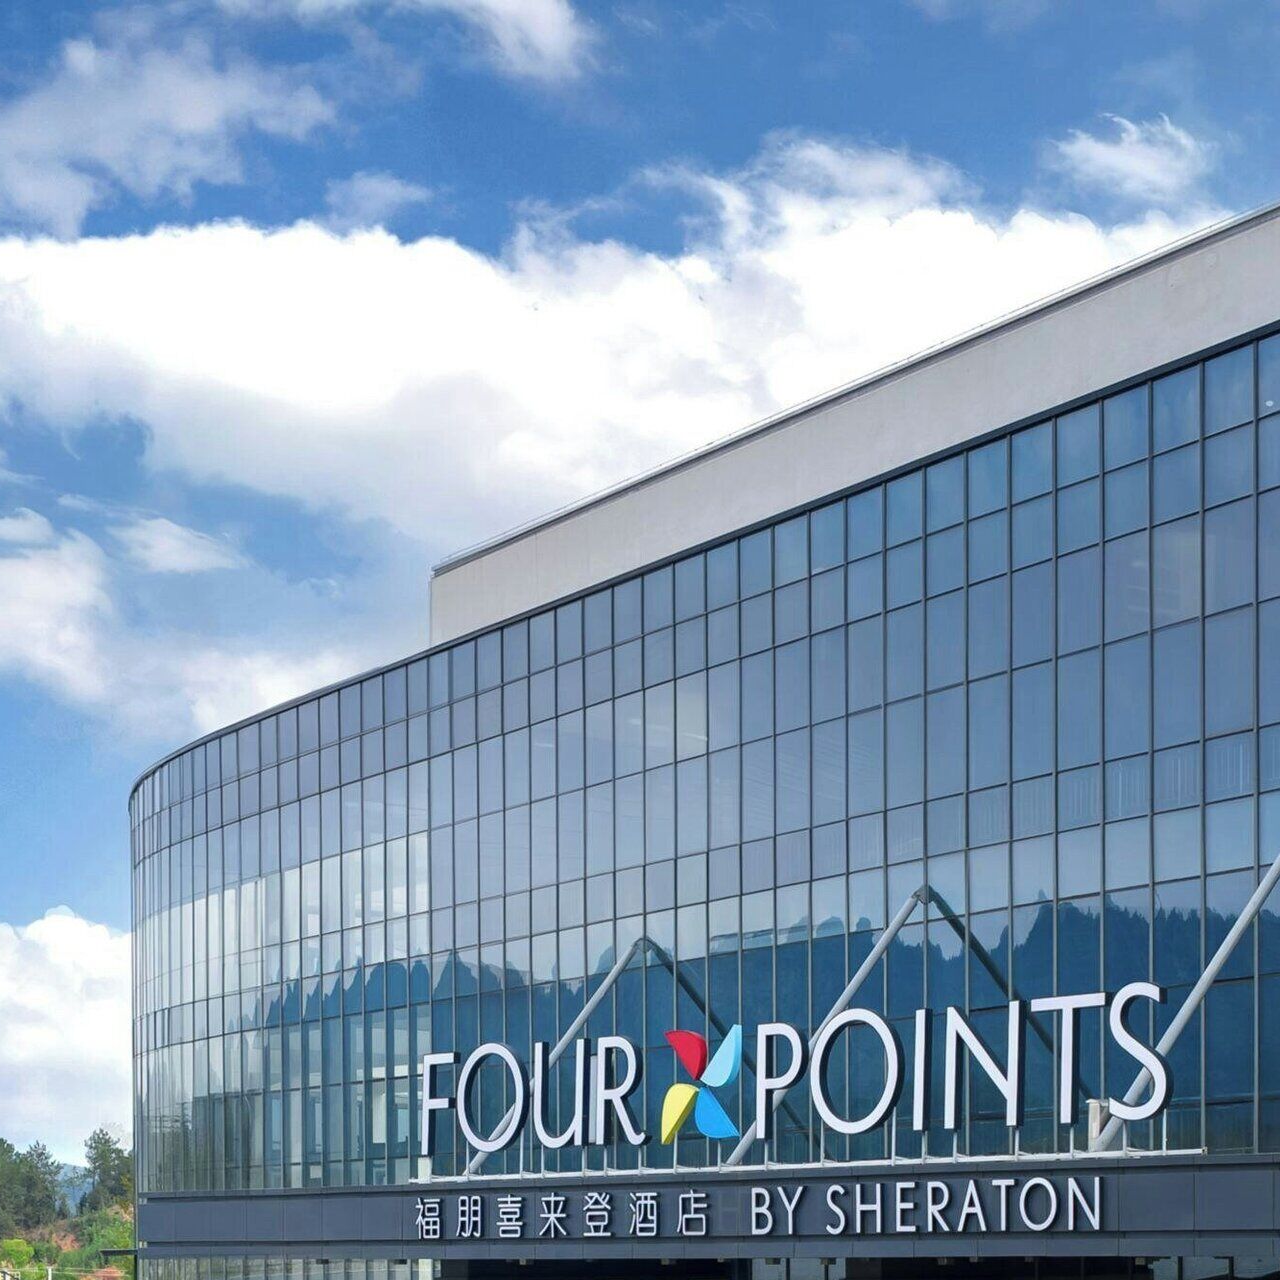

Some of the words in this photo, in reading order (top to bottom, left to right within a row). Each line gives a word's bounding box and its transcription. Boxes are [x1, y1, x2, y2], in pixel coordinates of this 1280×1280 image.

[421, 1035, 651, 1157] FOUR
[756, 980, 1172, 1140] POINTS
[415, 1190, 708, 1239] 福朋喜来登酒店
[751, 1185, 805, 1236] BY
[826, 1176, 1104, 1235] SHERATON
